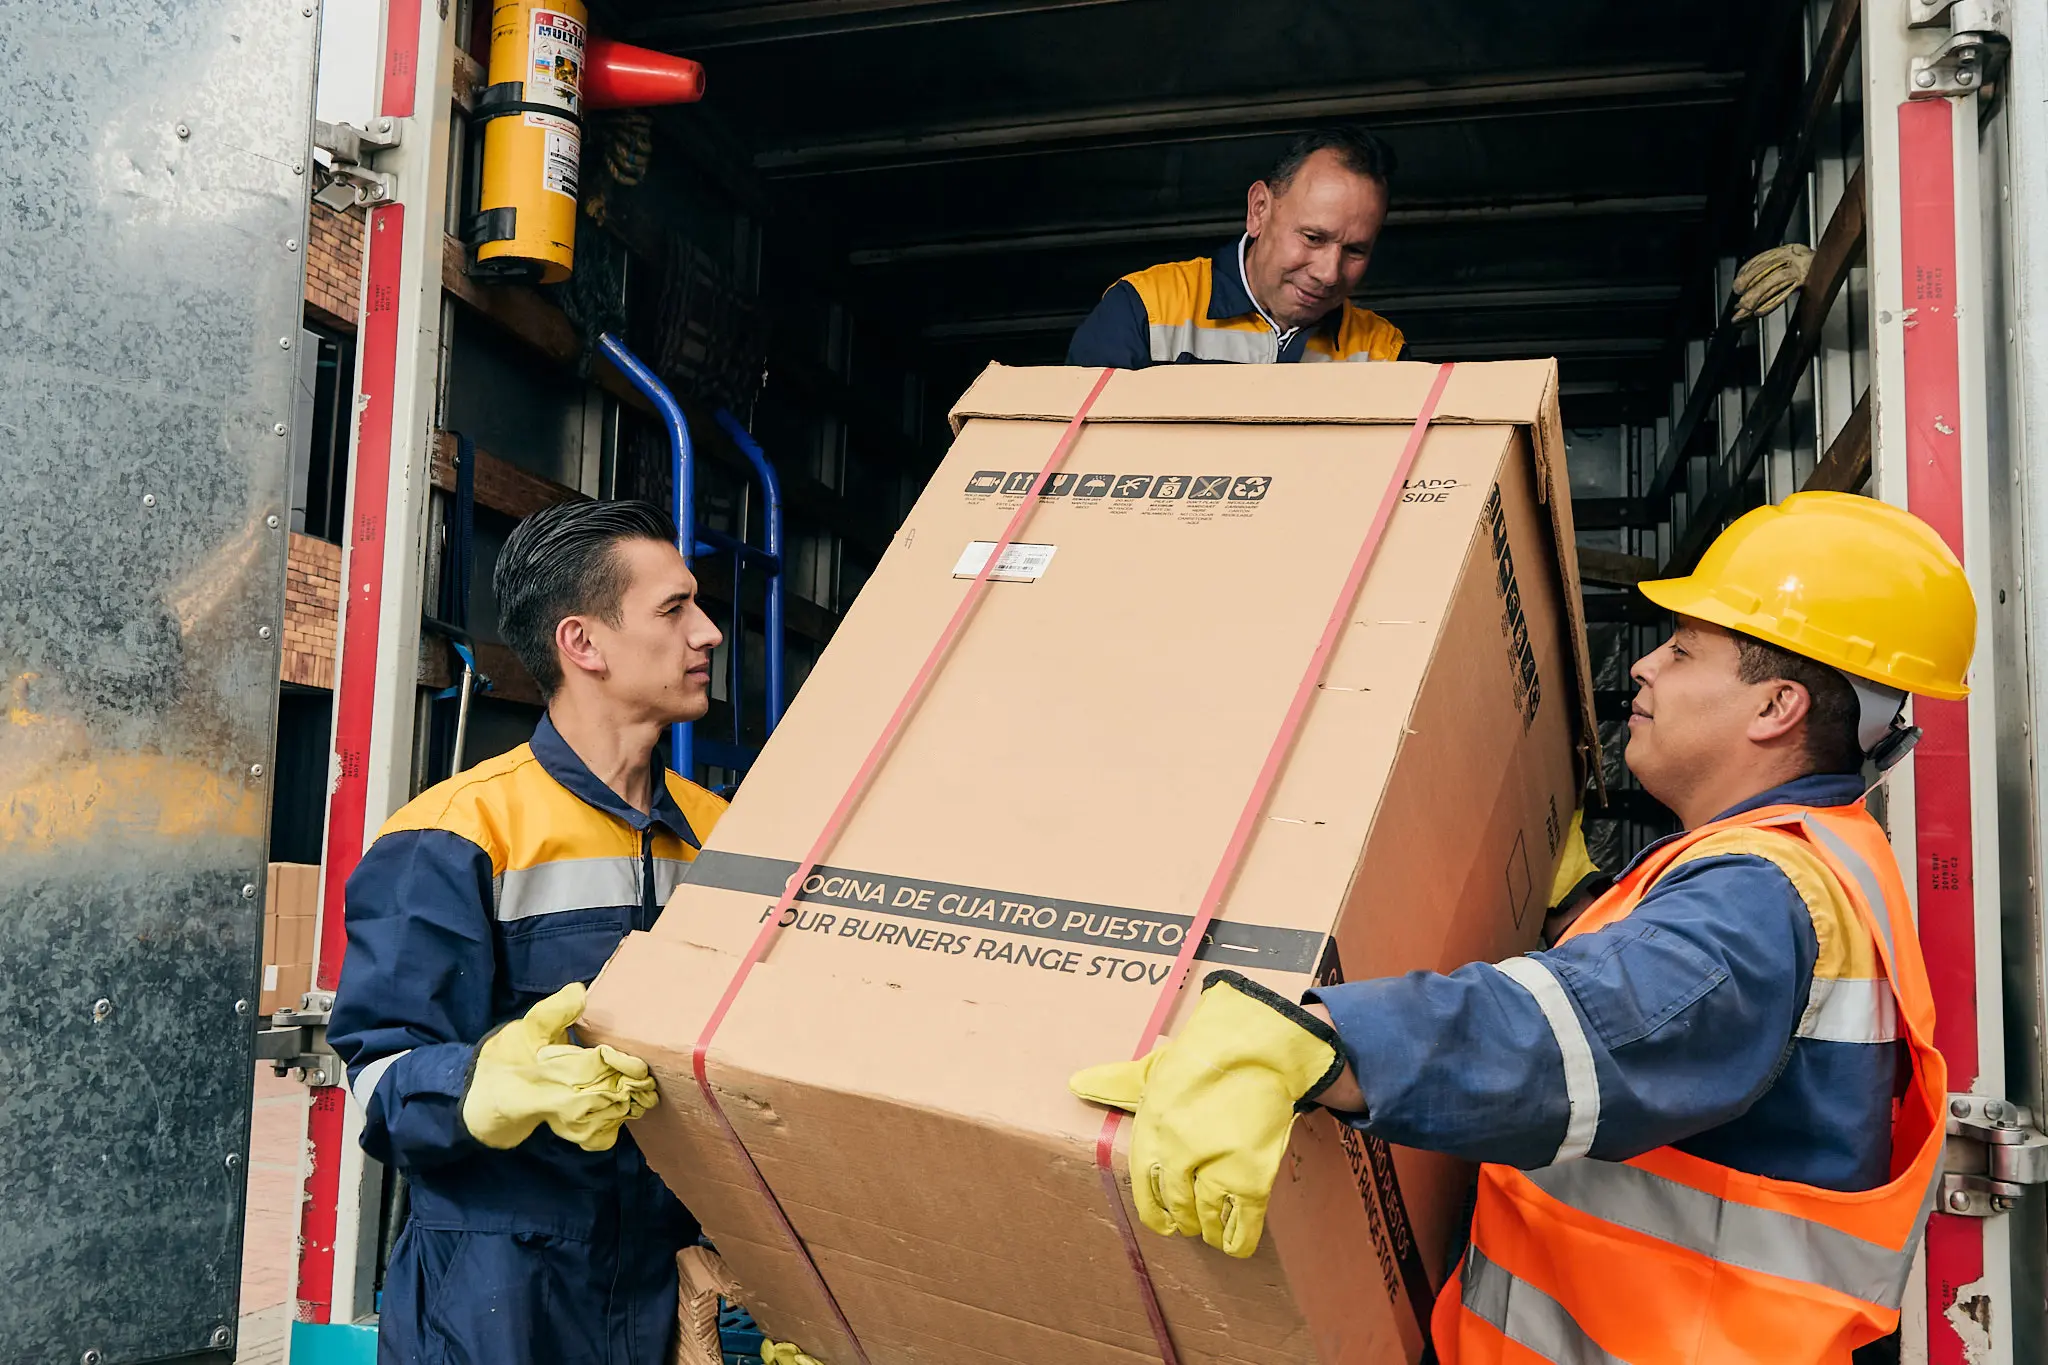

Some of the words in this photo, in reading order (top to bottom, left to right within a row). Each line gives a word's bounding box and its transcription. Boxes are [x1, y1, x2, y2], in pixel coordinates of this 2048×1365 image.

[1402, 479, 1457, 490] LADO
[1402, 492, 1449, 503] SIDE
[1932, 874, 1940, 890] NTC
[892, 886, 936, 911] DE
[937, 893, 1057, 929] CUATRO
[838, 917, 971, 955] BURNERS
[973, 938, 1082, 973] RANGE
[1086, 955, 1190, 990] STOV
[1358, 1165, 1382, 1245] RANGE
[1377, 1236, 1400, 1304] STOVE
[1382, 1170, 1410, 1260] PUESTOS
